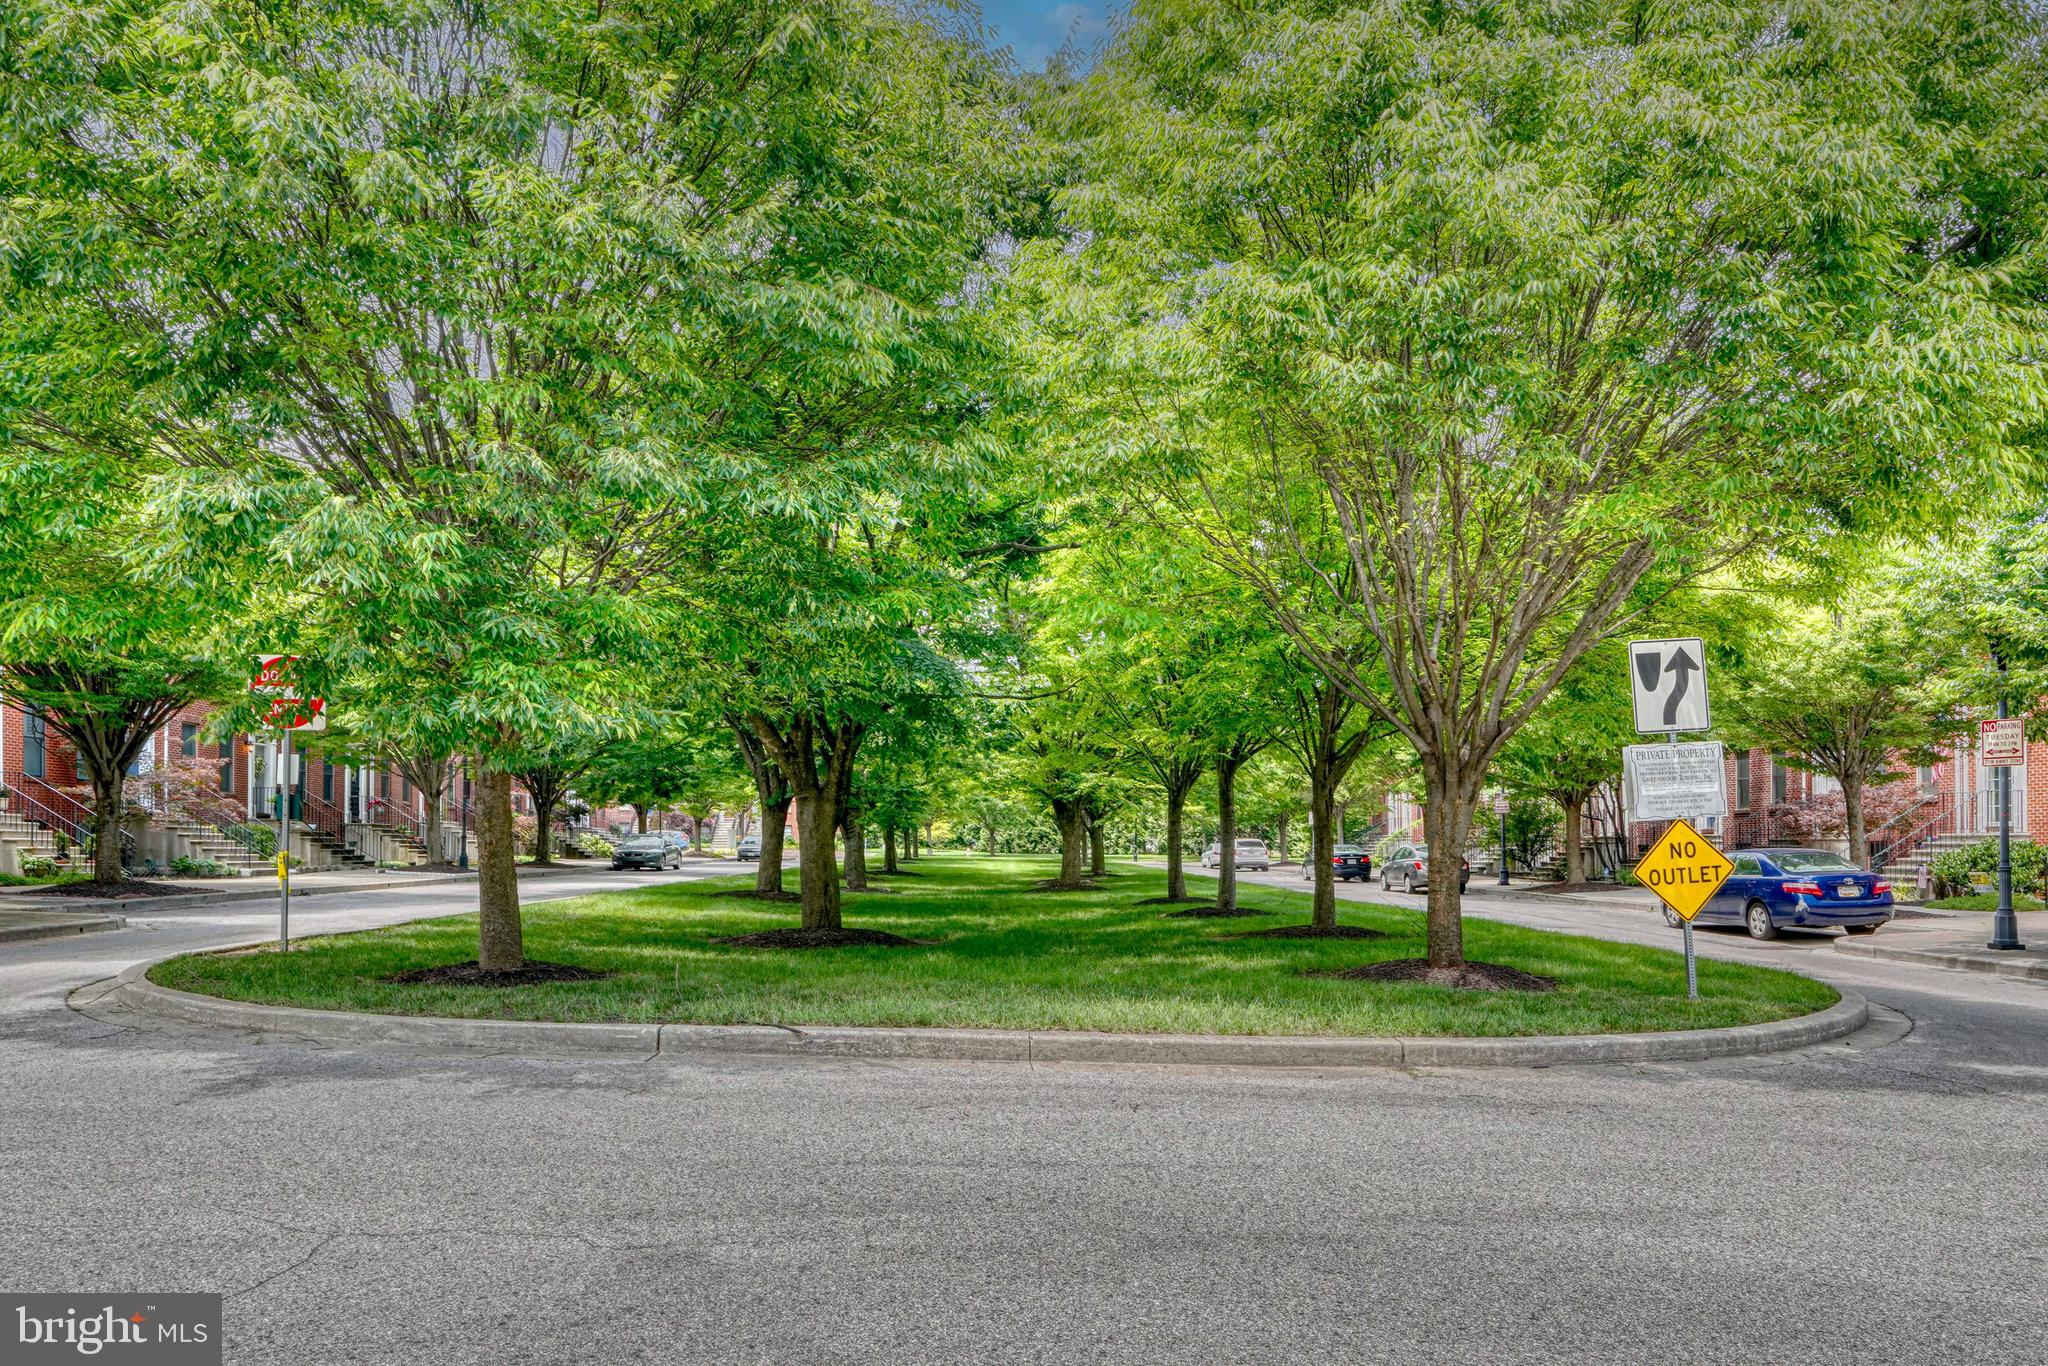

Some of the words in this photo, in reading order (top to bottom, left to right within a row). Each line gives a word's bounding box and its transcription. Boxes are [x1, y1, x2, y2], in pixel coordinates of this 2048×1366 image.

[1984, 722, 1996, 731] NO
[1997, 722, 2021, 730] PARKING
[1636, 750, 1670, 760] PRIVATE
[1673, 747, 1716, 759] PROPERTY
[1669, 841, 1697, 859] NO
[1649, 865, 1722, 886] OUTLET
